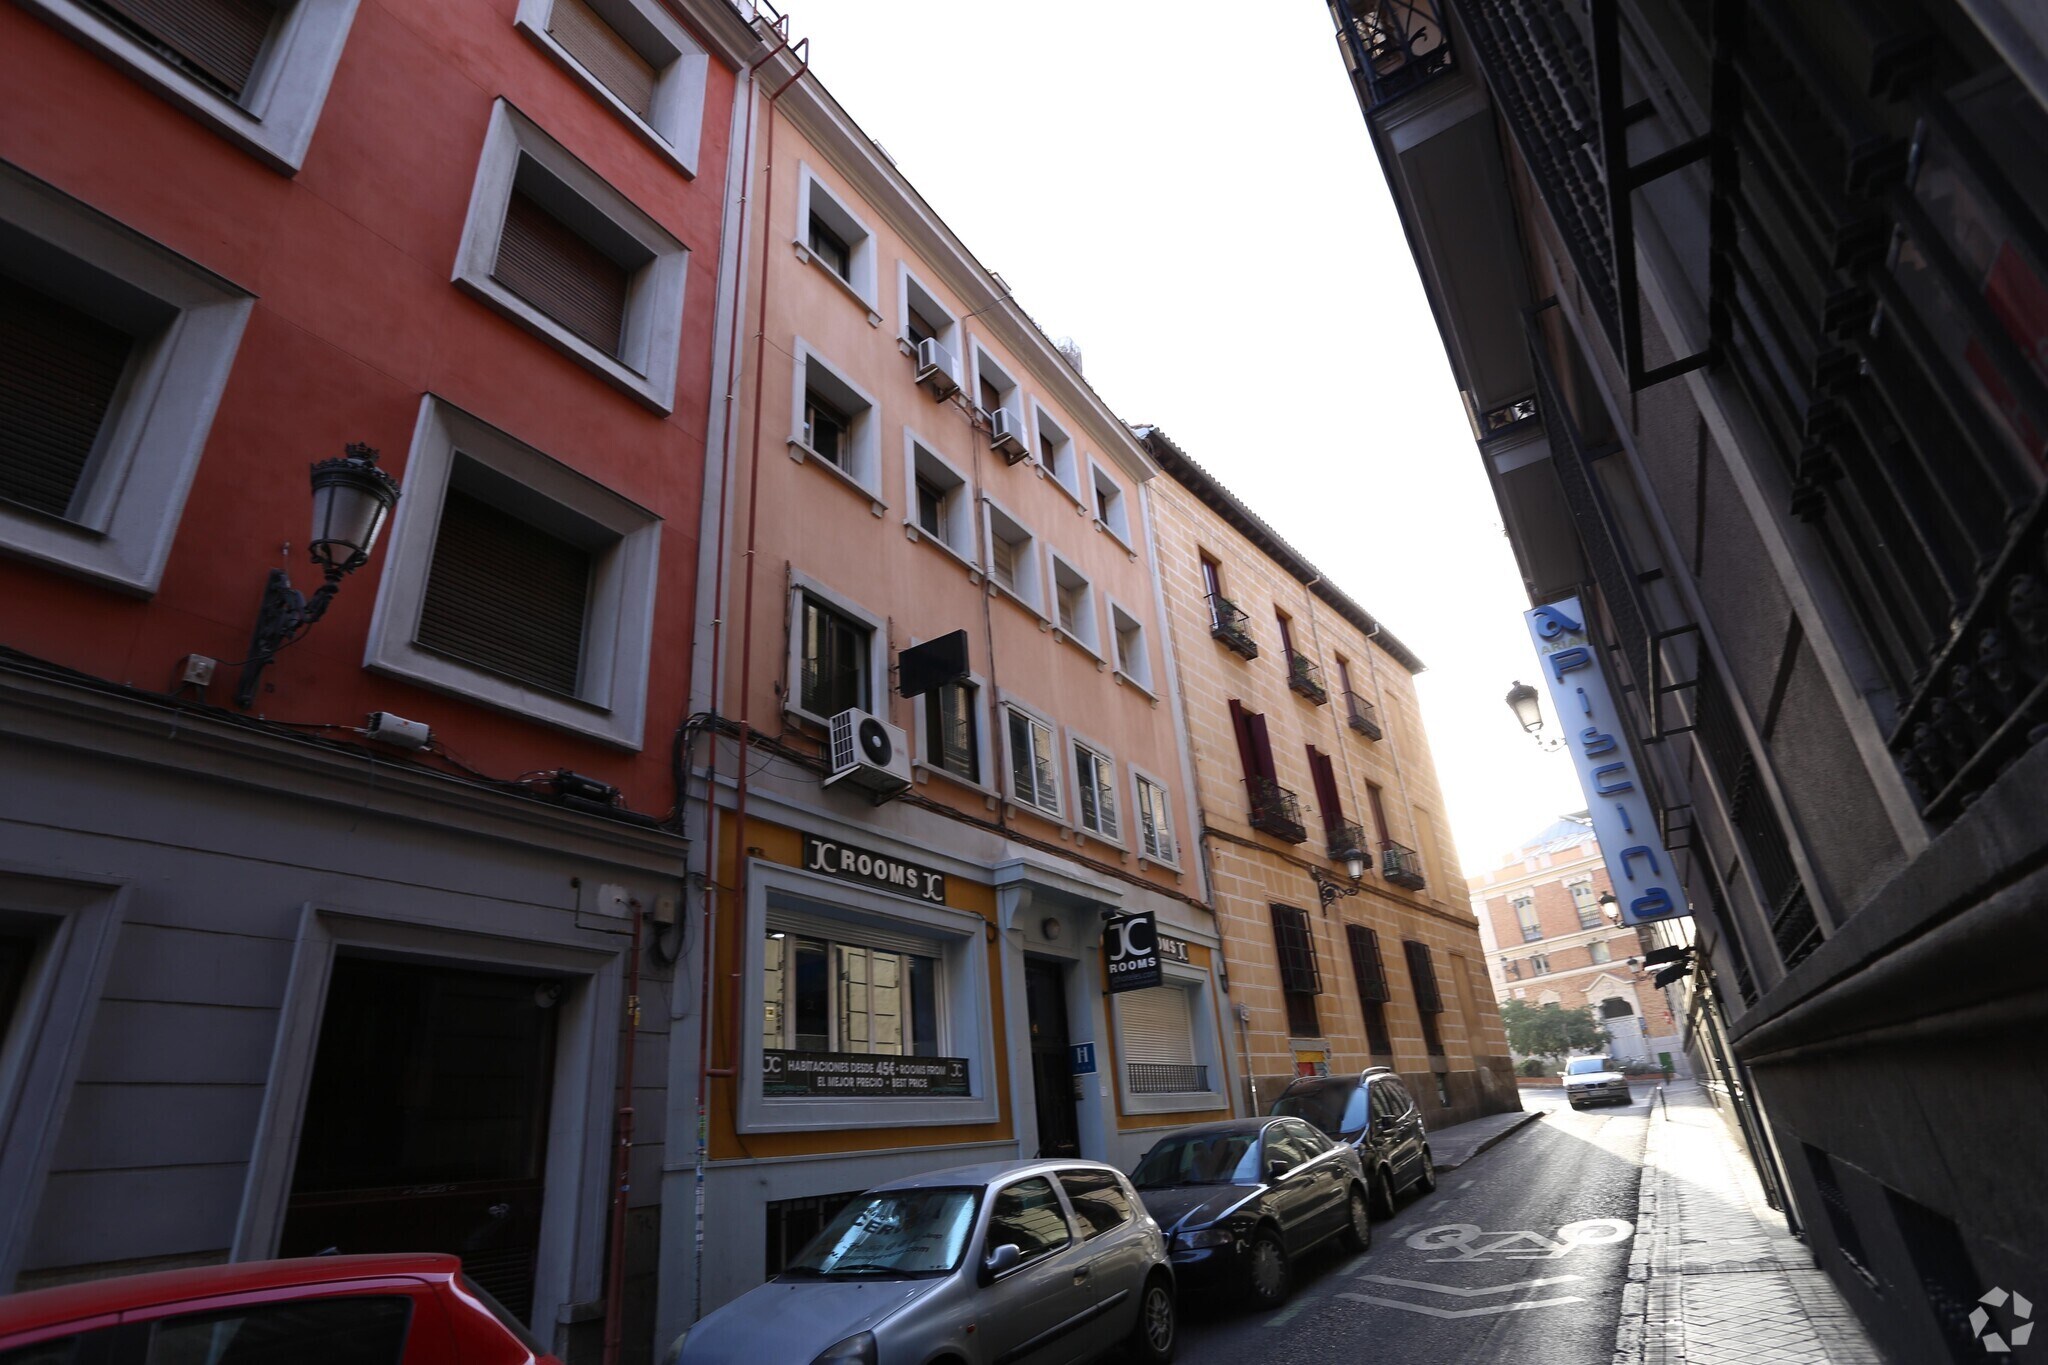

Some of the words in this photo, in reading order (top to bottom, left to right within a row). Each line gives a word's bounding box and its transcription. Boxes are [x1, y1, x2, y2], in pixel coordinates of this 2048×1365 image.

[809, 840, 837, 873] JC
[841, 849, 918, 888] ROOMS
[922, 872, 943, 901] JC
[1109, 918, 1151, 960] JC
[1109, 957, 1156, 974] ROOMS
[1076, 1046, 1089, 1064] H
[787, 1060, 849, 1073] HABITACIONES
[850, 1062, 874, 1074] DESDE
[900, 1064, 926, 1075] ROOMS
[927, 1065, 946, 1076] FROM
[817, 1076, 826, 1087] EL
[827, 1076, 855, 1088] MEJOR
[856, 1077, 883, 1088] PRECIO
[892, 1078, 907, 1088] BEST
[908, 1078, 928, 1088] PRICE
